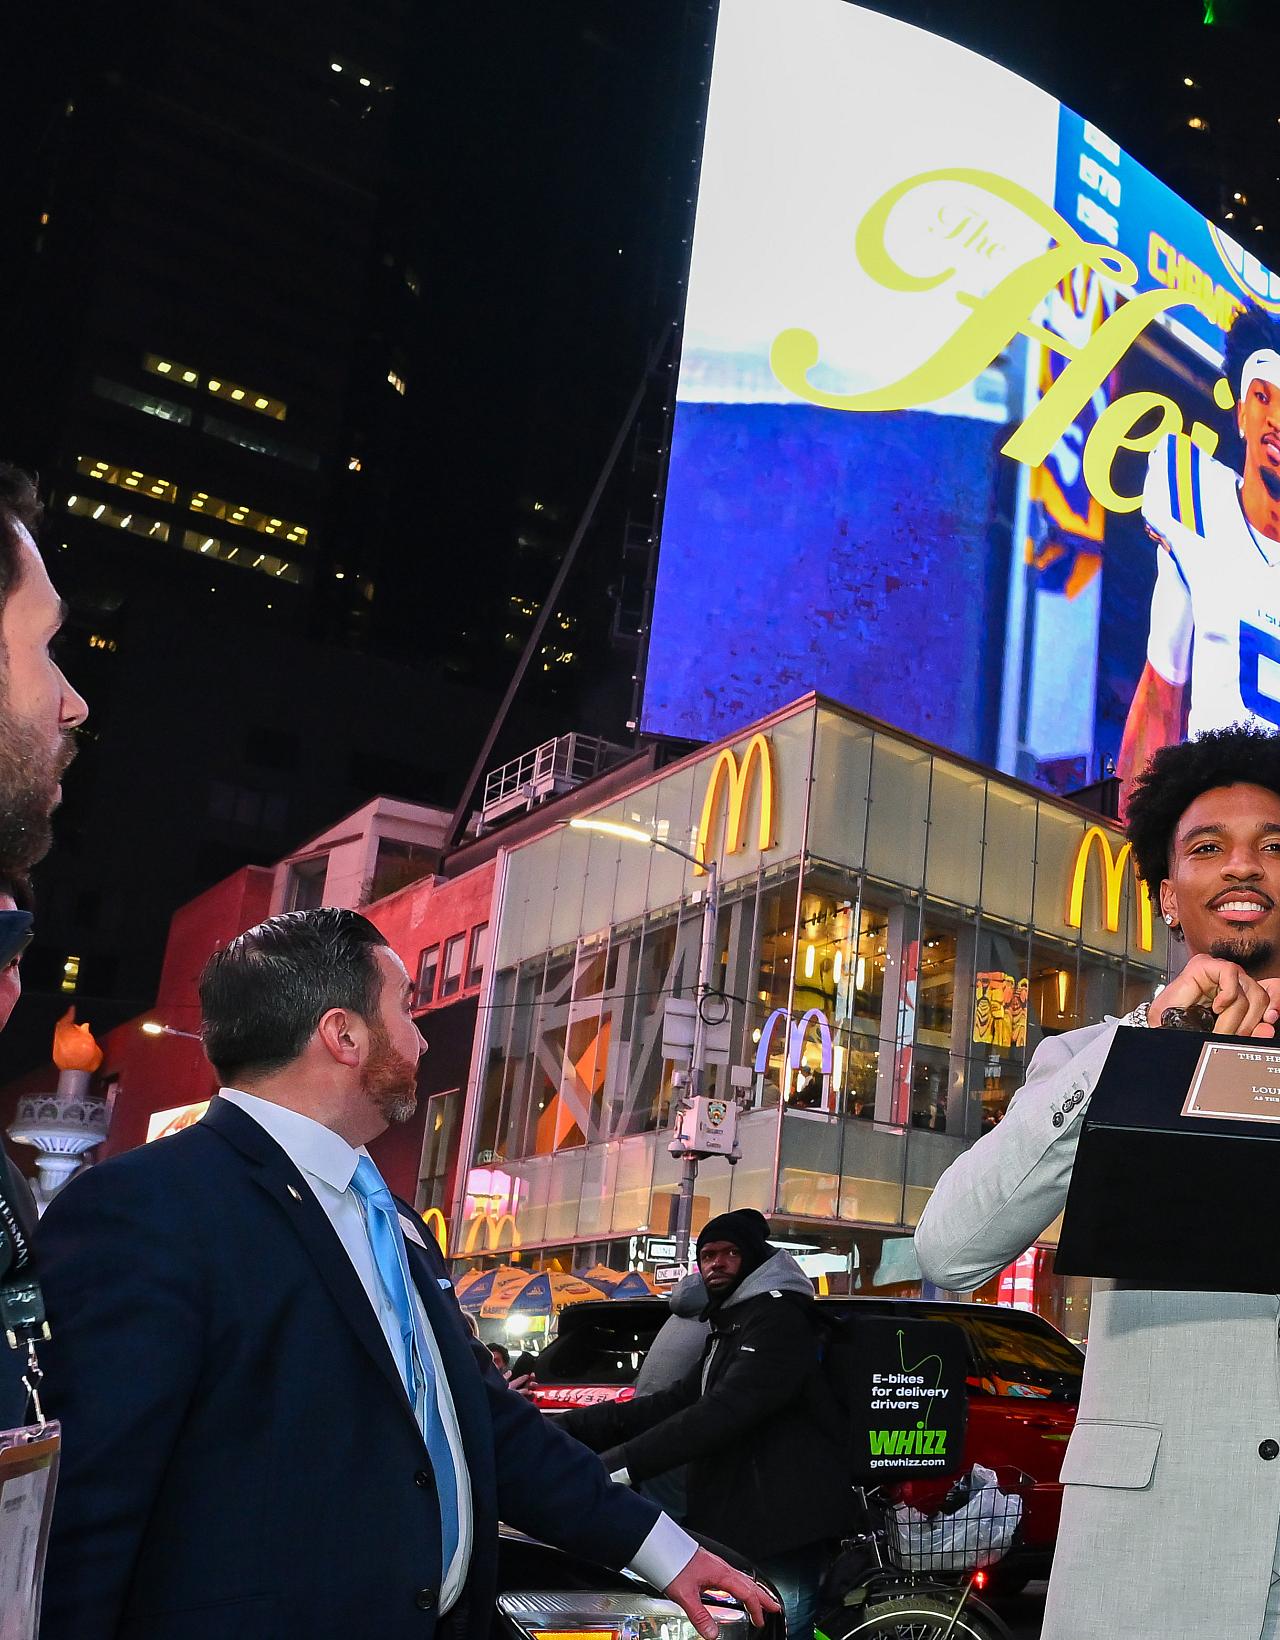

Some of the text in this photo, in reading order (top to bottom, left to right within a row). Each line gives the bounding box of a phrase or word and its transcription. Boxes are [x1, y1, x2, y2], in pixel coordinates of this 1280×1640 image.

[929, 205, 1006, 260] The
[1237, 1052, 1262, 1061] THE
[657, 1268, 685, 1278] ONE WAY
[872, 1373, 924, 1384] E-bikes
[871, 1386, 949, 1399] for delivery
[870, 1399, 920, 1409] drivers
[870, 1457, 945, 1469] getwhizz.com
